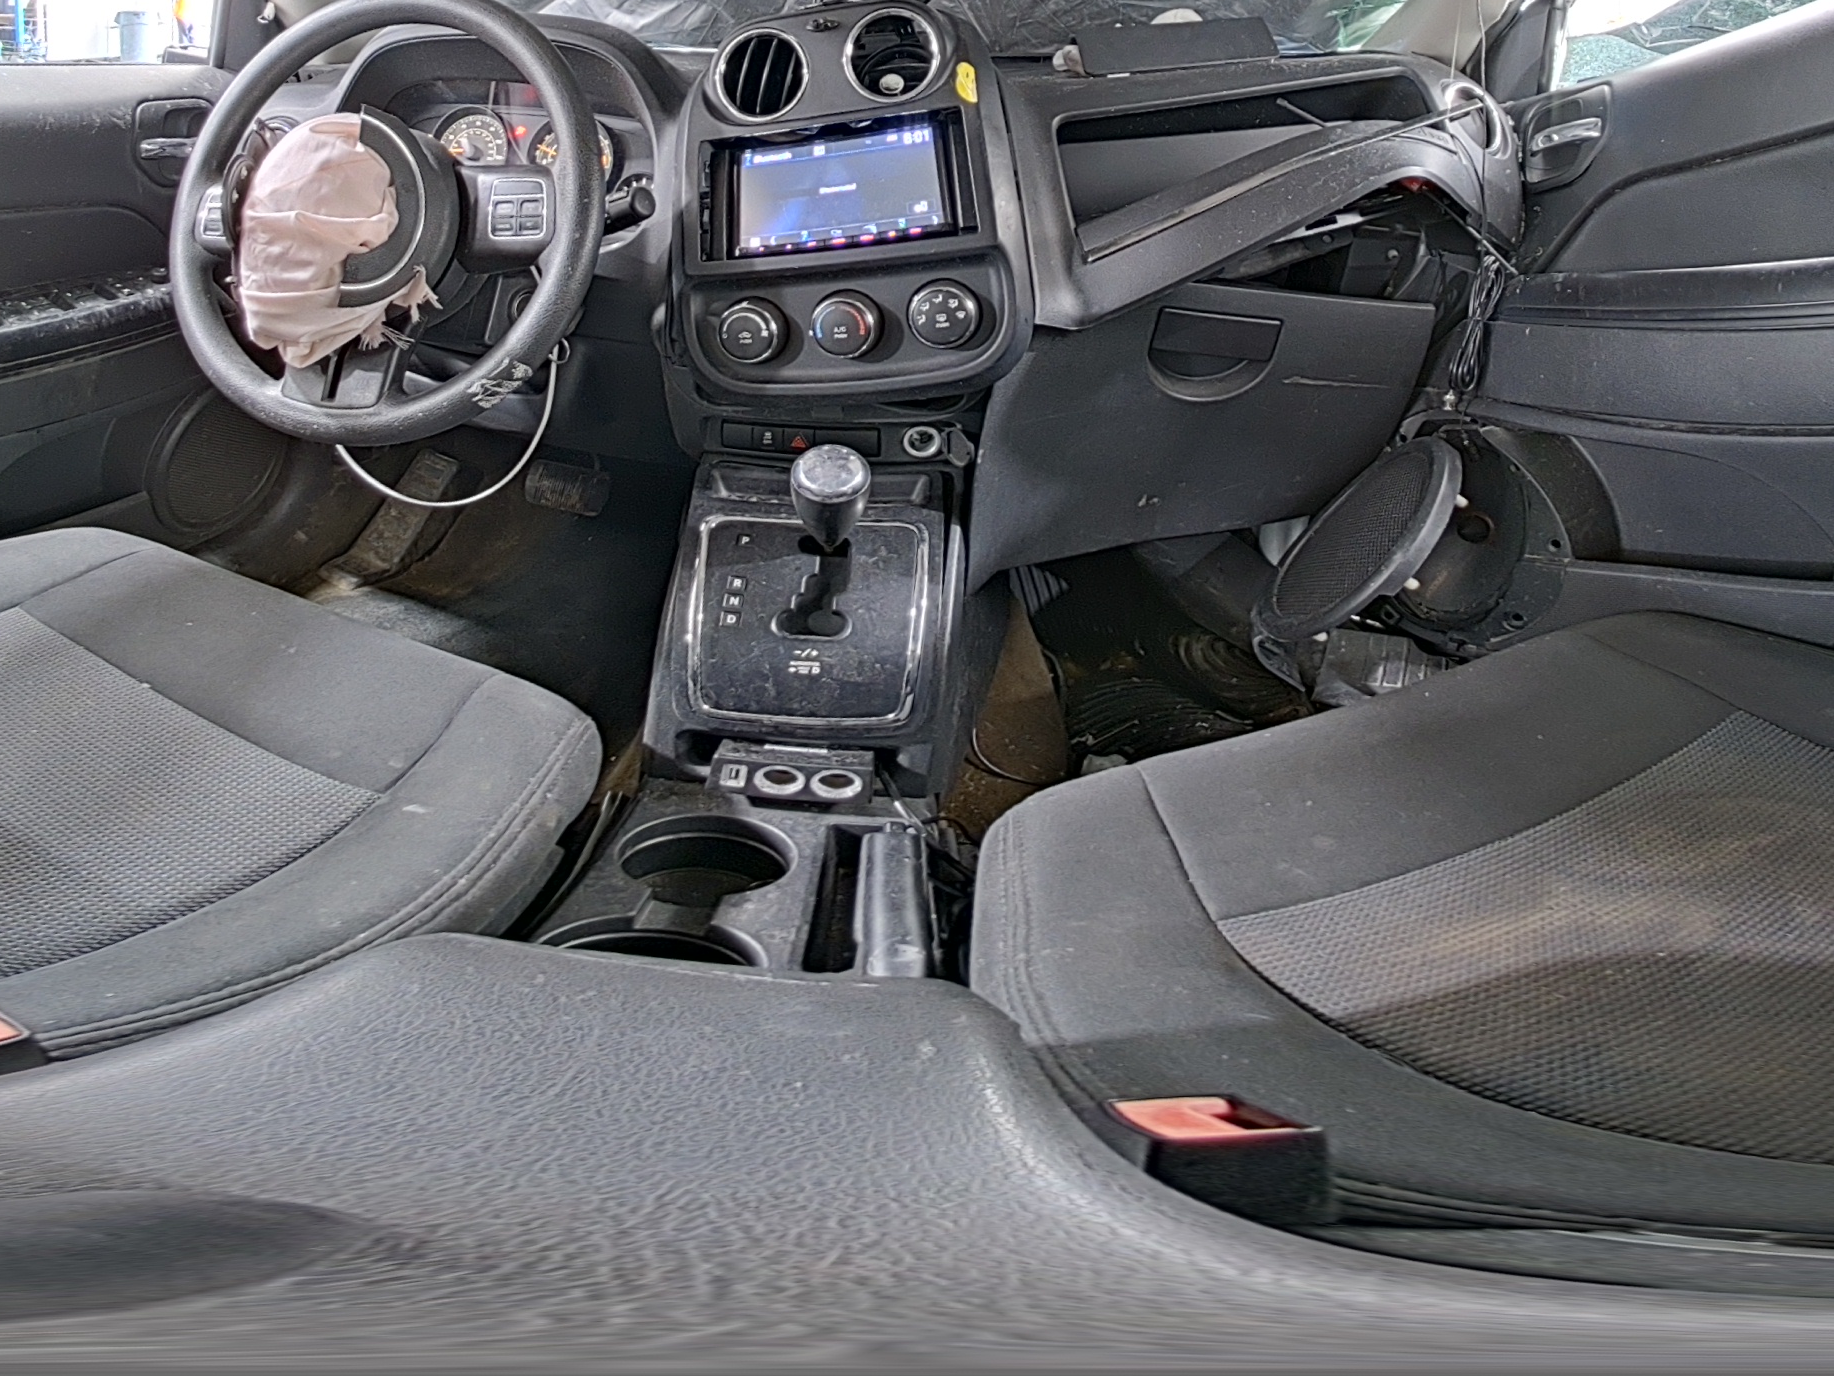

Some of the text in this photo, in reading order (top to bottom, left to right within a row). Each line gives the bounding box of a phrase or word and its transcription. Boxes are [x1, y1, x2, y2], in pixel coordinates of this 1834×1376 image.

[741, 536, 750, 544] P
[733, 578, 742, 587] R
[729, 596, 739, 606] N
[726, 614, 736, 624] D
